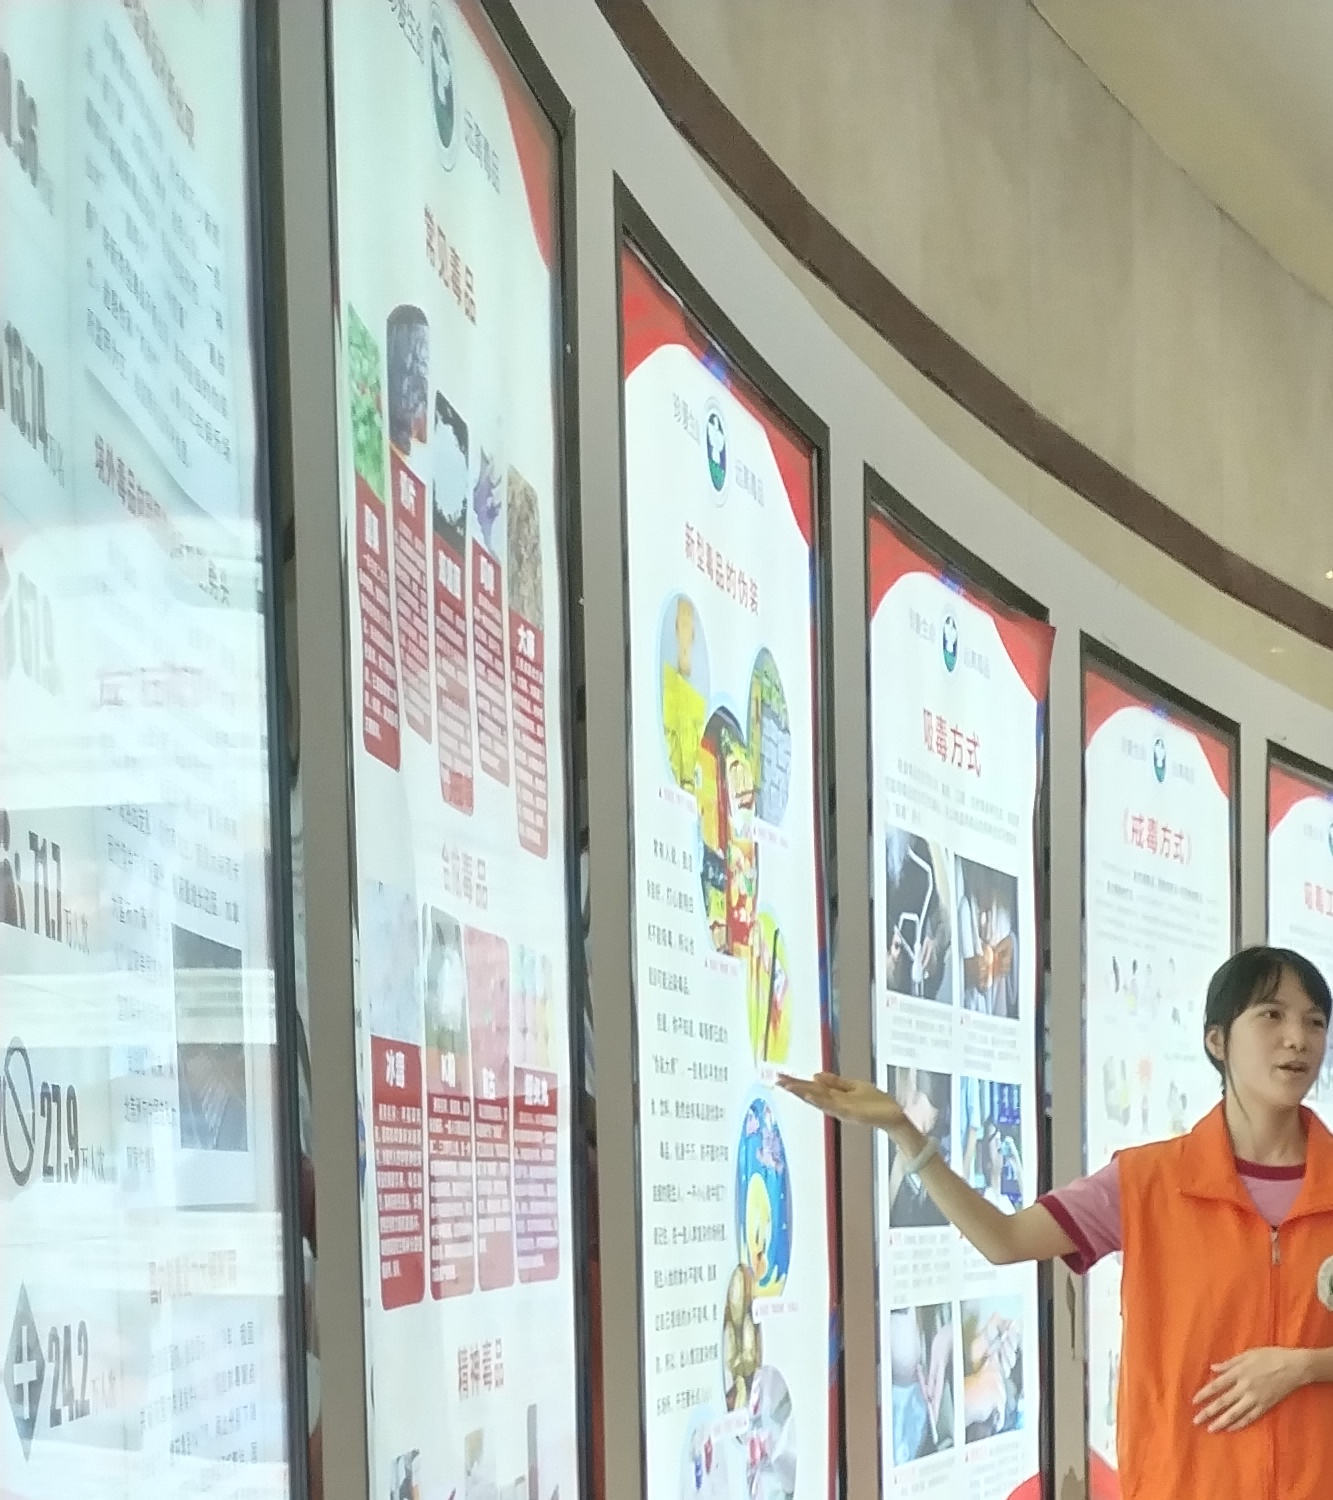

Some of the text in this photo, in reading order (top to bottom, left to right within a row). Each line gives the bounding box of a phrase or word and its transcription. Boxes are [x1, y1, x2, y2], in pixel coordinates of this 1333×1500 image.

[424, 202, 477, 325] 常见毒品
[684, 520, 759, 617] 新型毒品的伪装
[922, 706, 983, 779] 吸毒方式
